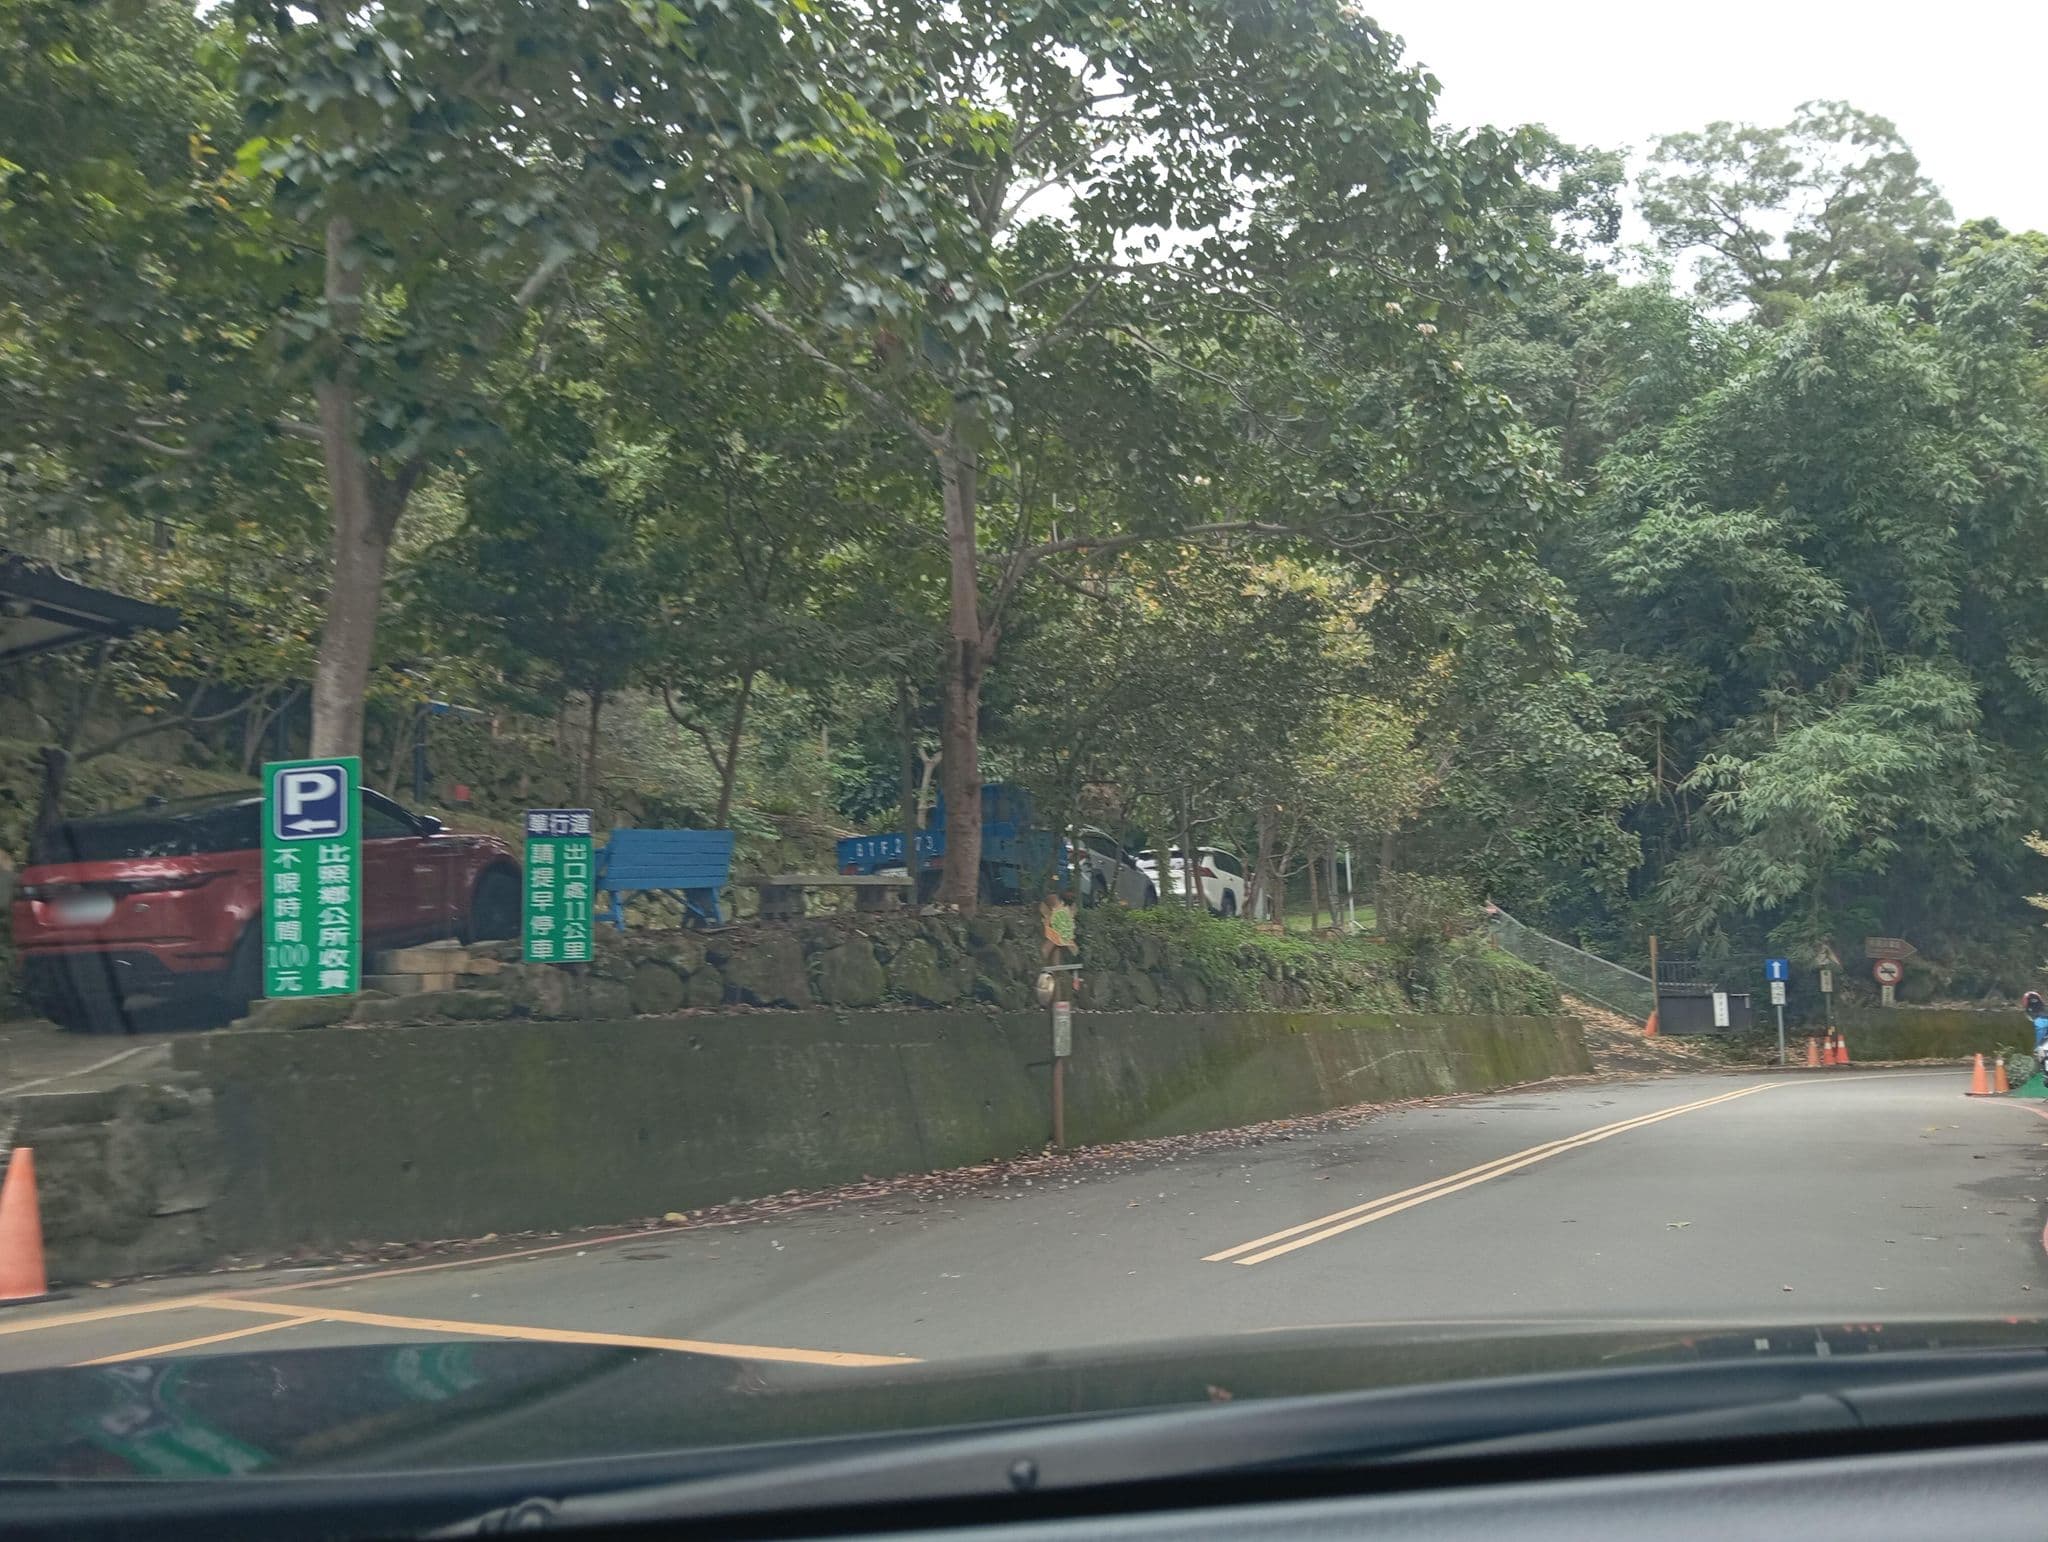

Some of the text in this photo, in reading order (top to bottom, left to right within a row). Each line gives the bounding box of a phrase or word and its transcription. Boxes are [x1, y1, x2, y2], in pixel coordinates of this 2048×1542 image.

[284, 772, 337, 816] P
[267, 848, 310, 992] 不限時間100元
[530, 843, 556, 959] 請提早停車
